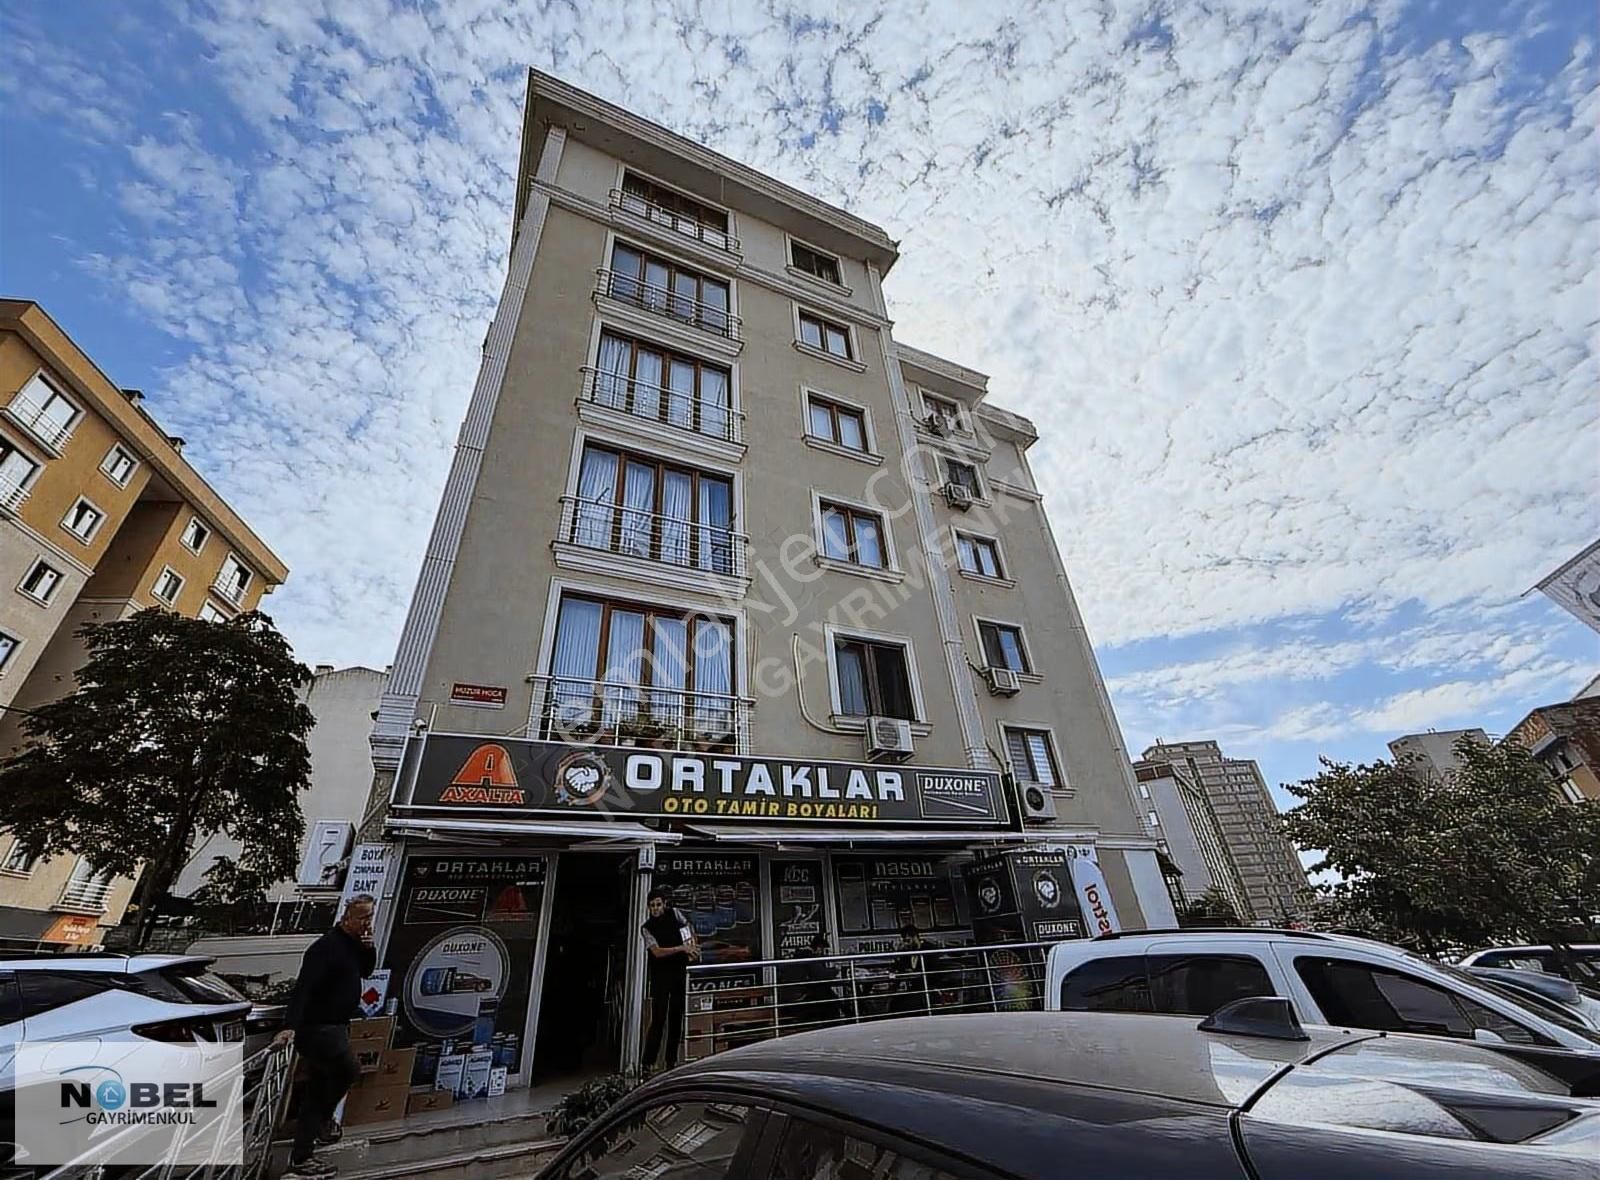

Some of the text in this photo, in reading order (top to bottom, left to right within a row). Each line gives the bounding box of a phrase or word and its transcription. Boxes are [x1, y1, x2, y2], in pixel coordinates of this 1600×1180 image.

[625, 754, 905, 801] ORTAKLAR
[924, 777, 982, 792] DUXONE
[440, 787, 526, 804] AXALTA
[664, 797, 878, 819] OTO TAMİR BOYALARI
[436, 861, 541, 873] ORTAKLAR
[673, 860, 751, 870] ORTAKLAR
[875, 861, 935, 876] nason
[353, 880, 378, 892] BANT
[416, 889, 480, 901] DUXONE
[781, 935, 816, 947] MIRK
[443, 942, 487, 953] DUXONE
